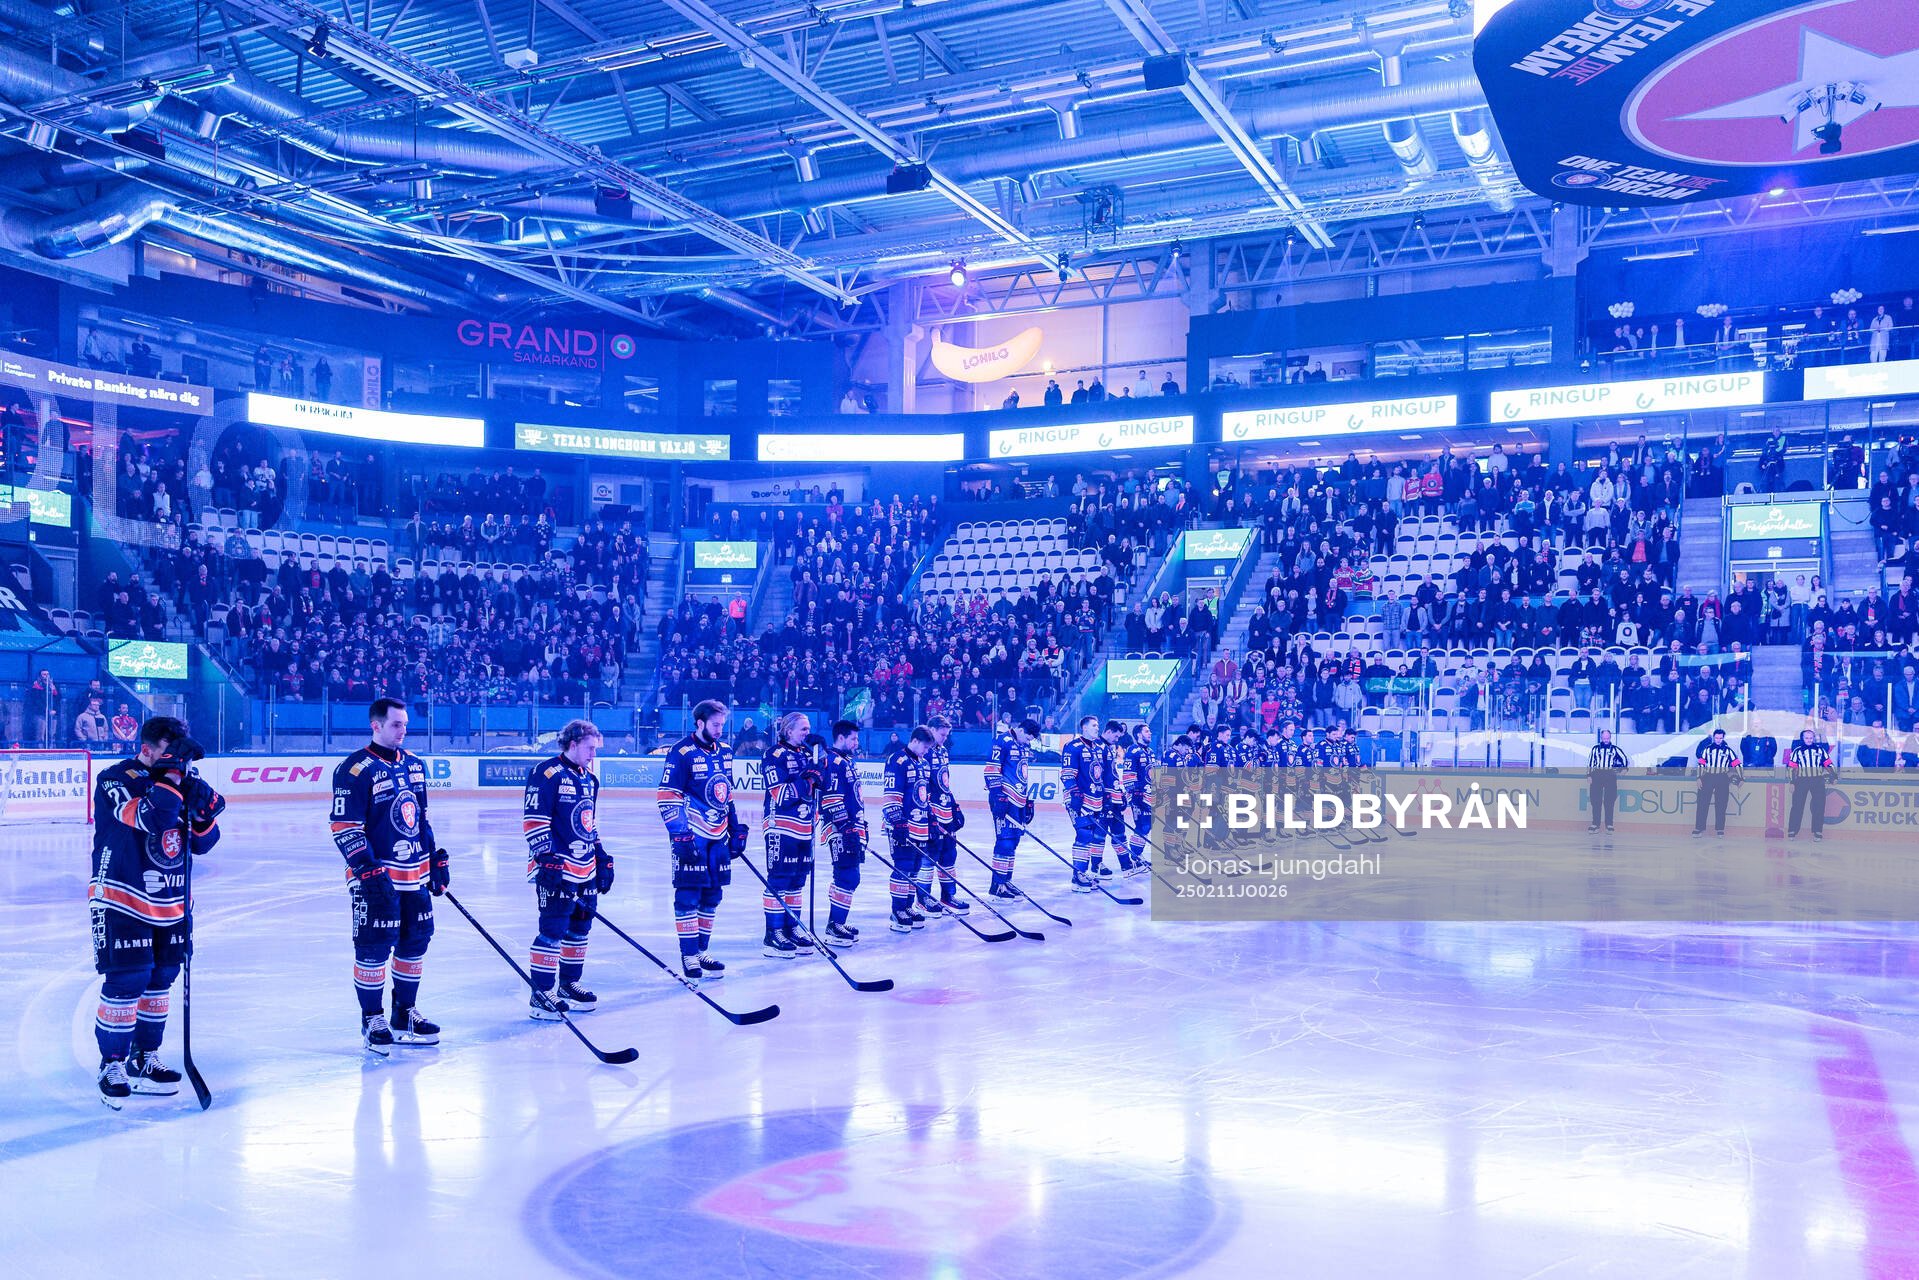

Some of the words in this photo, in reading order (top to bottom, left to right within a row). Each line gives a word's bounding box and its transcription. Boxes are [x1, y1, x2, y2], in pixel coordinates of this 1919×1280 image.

[1510, 11, 1634, 77] DREAM
[1597, 15, 1686, 64] TEAM
[1557, 155, 1623, 173] ONE
[1613, 165, 1690, 185] TEAM
[1594, 177, 1702, 200] DREAM
[457, 319, 598, 356] GRAND
[513, 351, 598, 369] SAMARKAND
[962, 348, 1009, 370] LOHILO
[48, 369, 92, 389] Private
[94, 378, 148, 399] Banking
[150, 387, 178, 402] nära
[179, 391, 200, 407] dig
[366, 365, 380, 409] OHILO
[1663, 376, 1752, 398] RINGUP
[1529, 386, 1612, 408] RINGUP
[1256, 409, 1327, 428] RINGUP
[1371, 400, 1447, 419] RINGUP
[1018, 428, 1081, 446] RINGUP
[1119, 419, 1185, 437] RINGUP
[552, 433, 592, 449] TEXAS
[595, 434, 656, 454] LONGHORN
[659, 438, 696, 455] VÄXJÖ
[230, 766, 324, 784] CCM
[372, 771, 388, 784] wilo
[486, 767, 526, 777] EVENT
[605, 773, 654, 784] BJURFORS
[765, 768, 779, 786] 18
[334, 787, 352, 796] iljas
[733, 777, 766, 790] WEL
[524, 793, 540, 810] 24
[1456, 788, 1540, 807] MDCON
[1579, 788, 1751, 816] HDSUPY
[1771, 786, 1780, 825] CCM
[97, 905, 107, 950] ORDIC
[372, 919, 401, 928] ÄLMB
